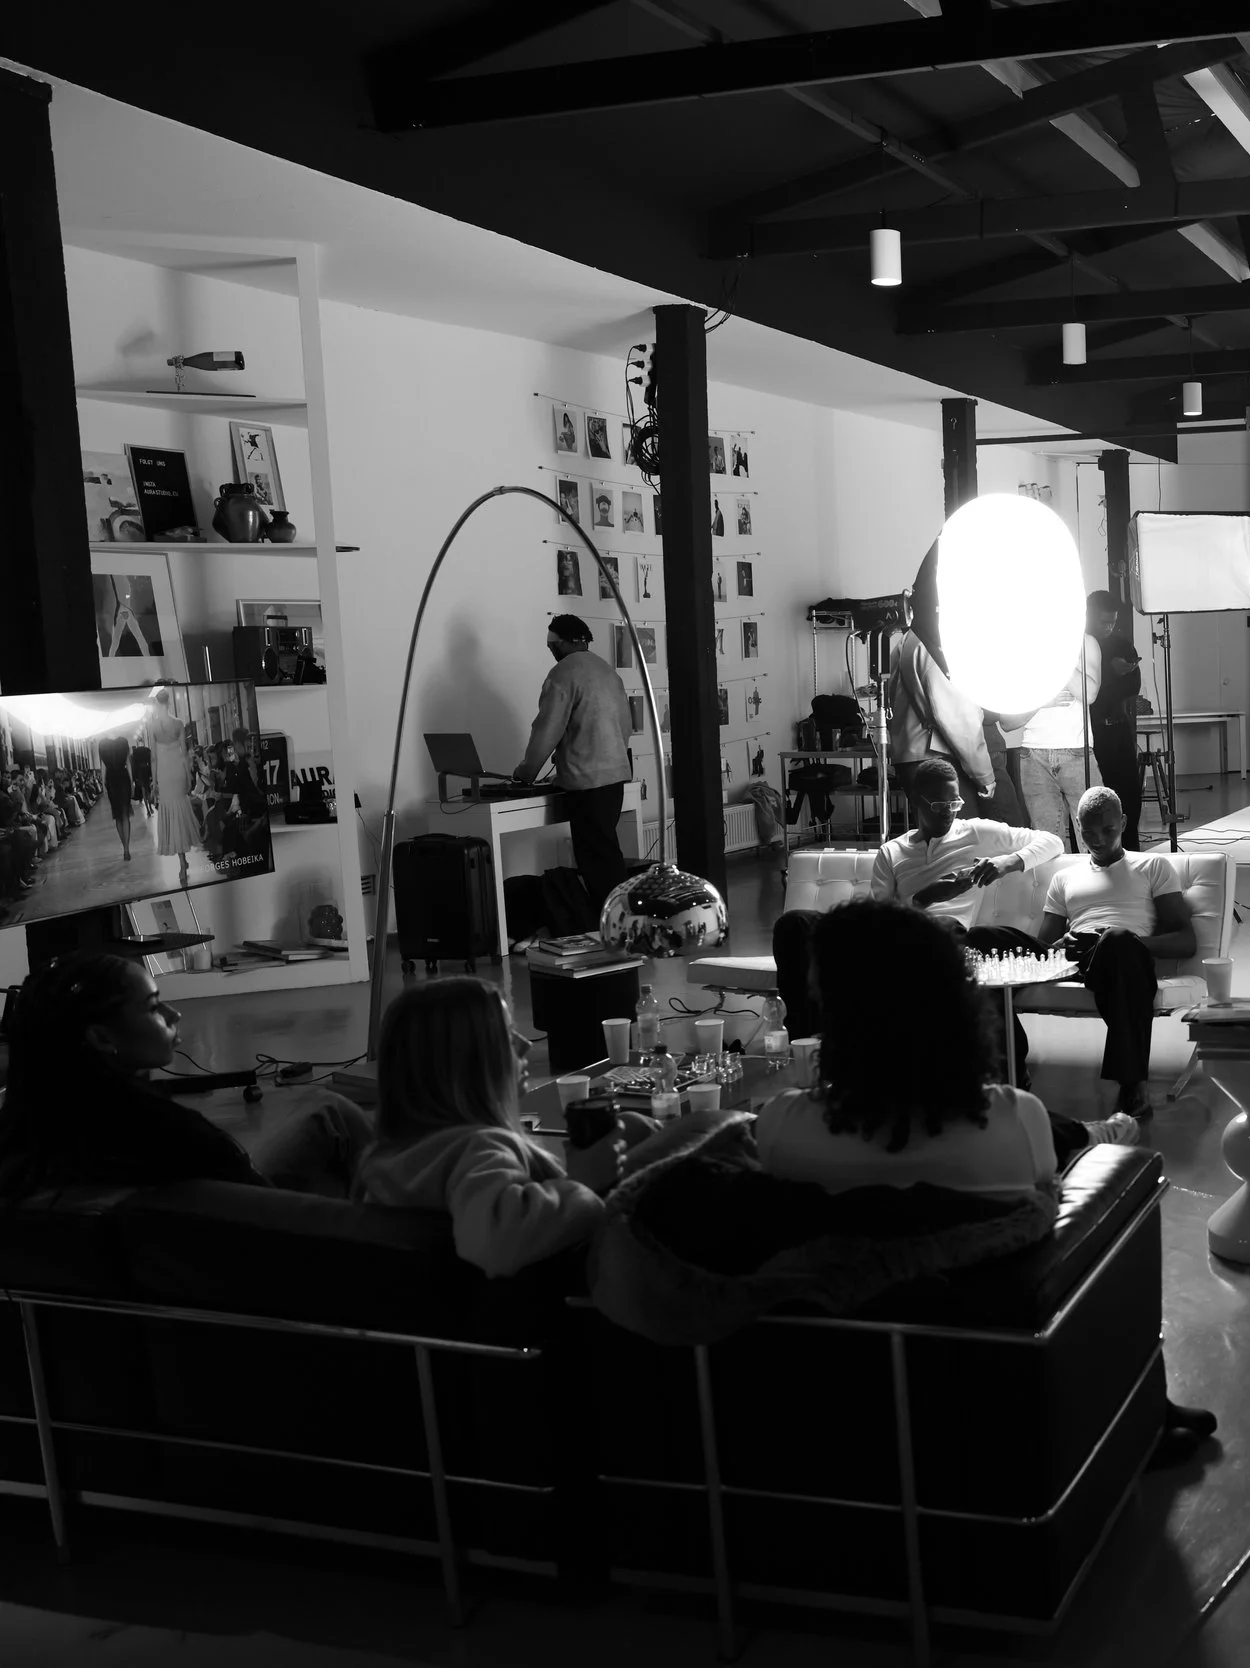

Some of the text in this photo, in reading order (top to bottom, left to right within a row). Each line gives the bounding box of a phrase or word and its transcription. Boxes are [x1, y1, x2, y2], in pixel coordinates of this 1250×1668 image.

[263, 759, 280, 786] 17
[289, 766, 335, 790] AUR
[232, 853, 264, 867] HOBEIKA
